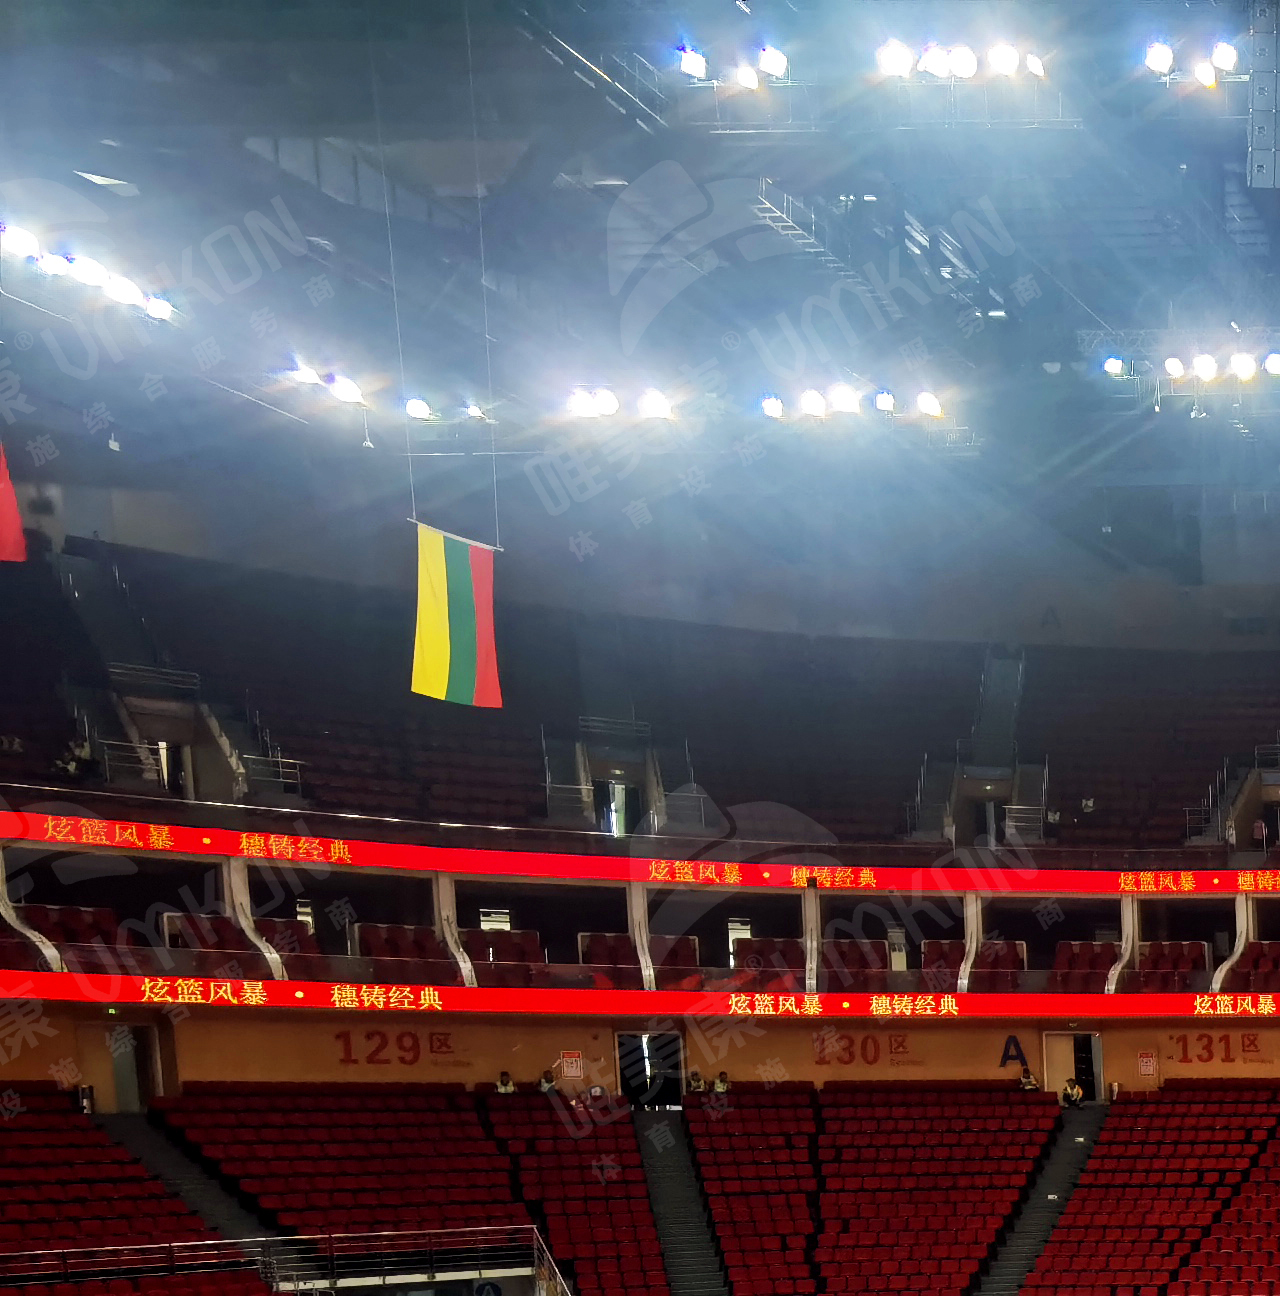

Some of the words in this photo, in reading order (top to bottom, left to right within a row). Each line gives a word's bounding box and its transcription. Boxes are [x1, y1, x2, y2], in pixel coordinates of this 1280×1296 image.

[141, 978, 268, 1004] 炫篮风暴
[331, 985, 442, 1010] 穗铸经典
[729, 992, 823, 1015] 炫篮风暴
[870, 994, 959, 1016] 穗铸经典
[1194, 994, 1276, 1014] 炫篮风暴
[335, 1030, 454, 1066] 129区
[1000, 1034, 1029, 1067] A
[1175, 1033, 1260, 1064] 131区
